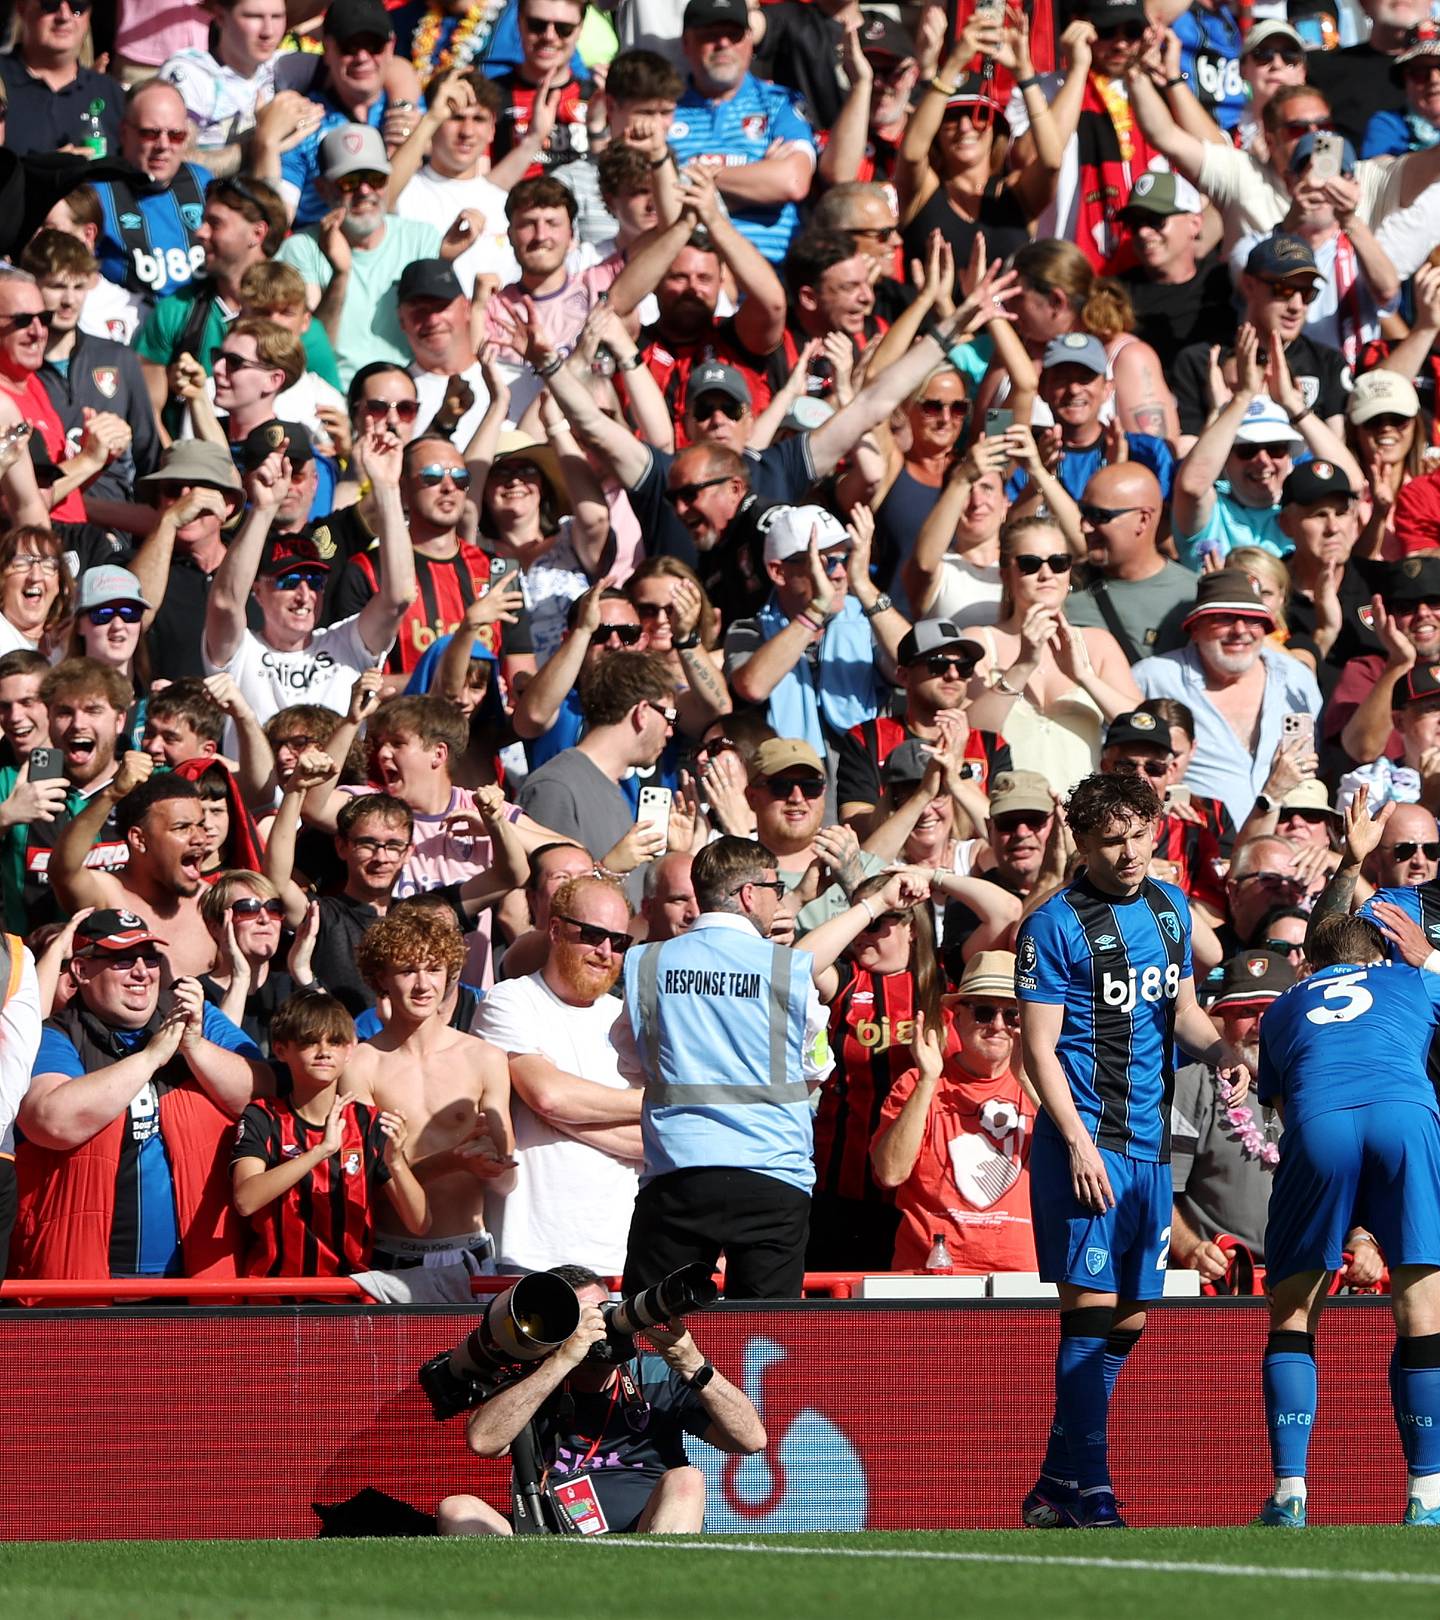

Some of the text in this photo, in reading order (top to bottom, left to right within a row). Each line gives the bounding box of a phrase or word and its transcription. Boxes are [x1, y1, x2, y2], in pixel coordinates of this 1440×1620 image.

[1197, 55, 1246, 102] bj8
[665, 969, 760, 998] RESPONSE TEAM
[1103, 963, 1180, 1013] bj88
[1306, 971, 1373, 1025] 3
[857, 1016, 914, 1054] bj8
[432, 1241, 453, 1251] Klein
[1277, 1413, 1311, 1425] AFCB
